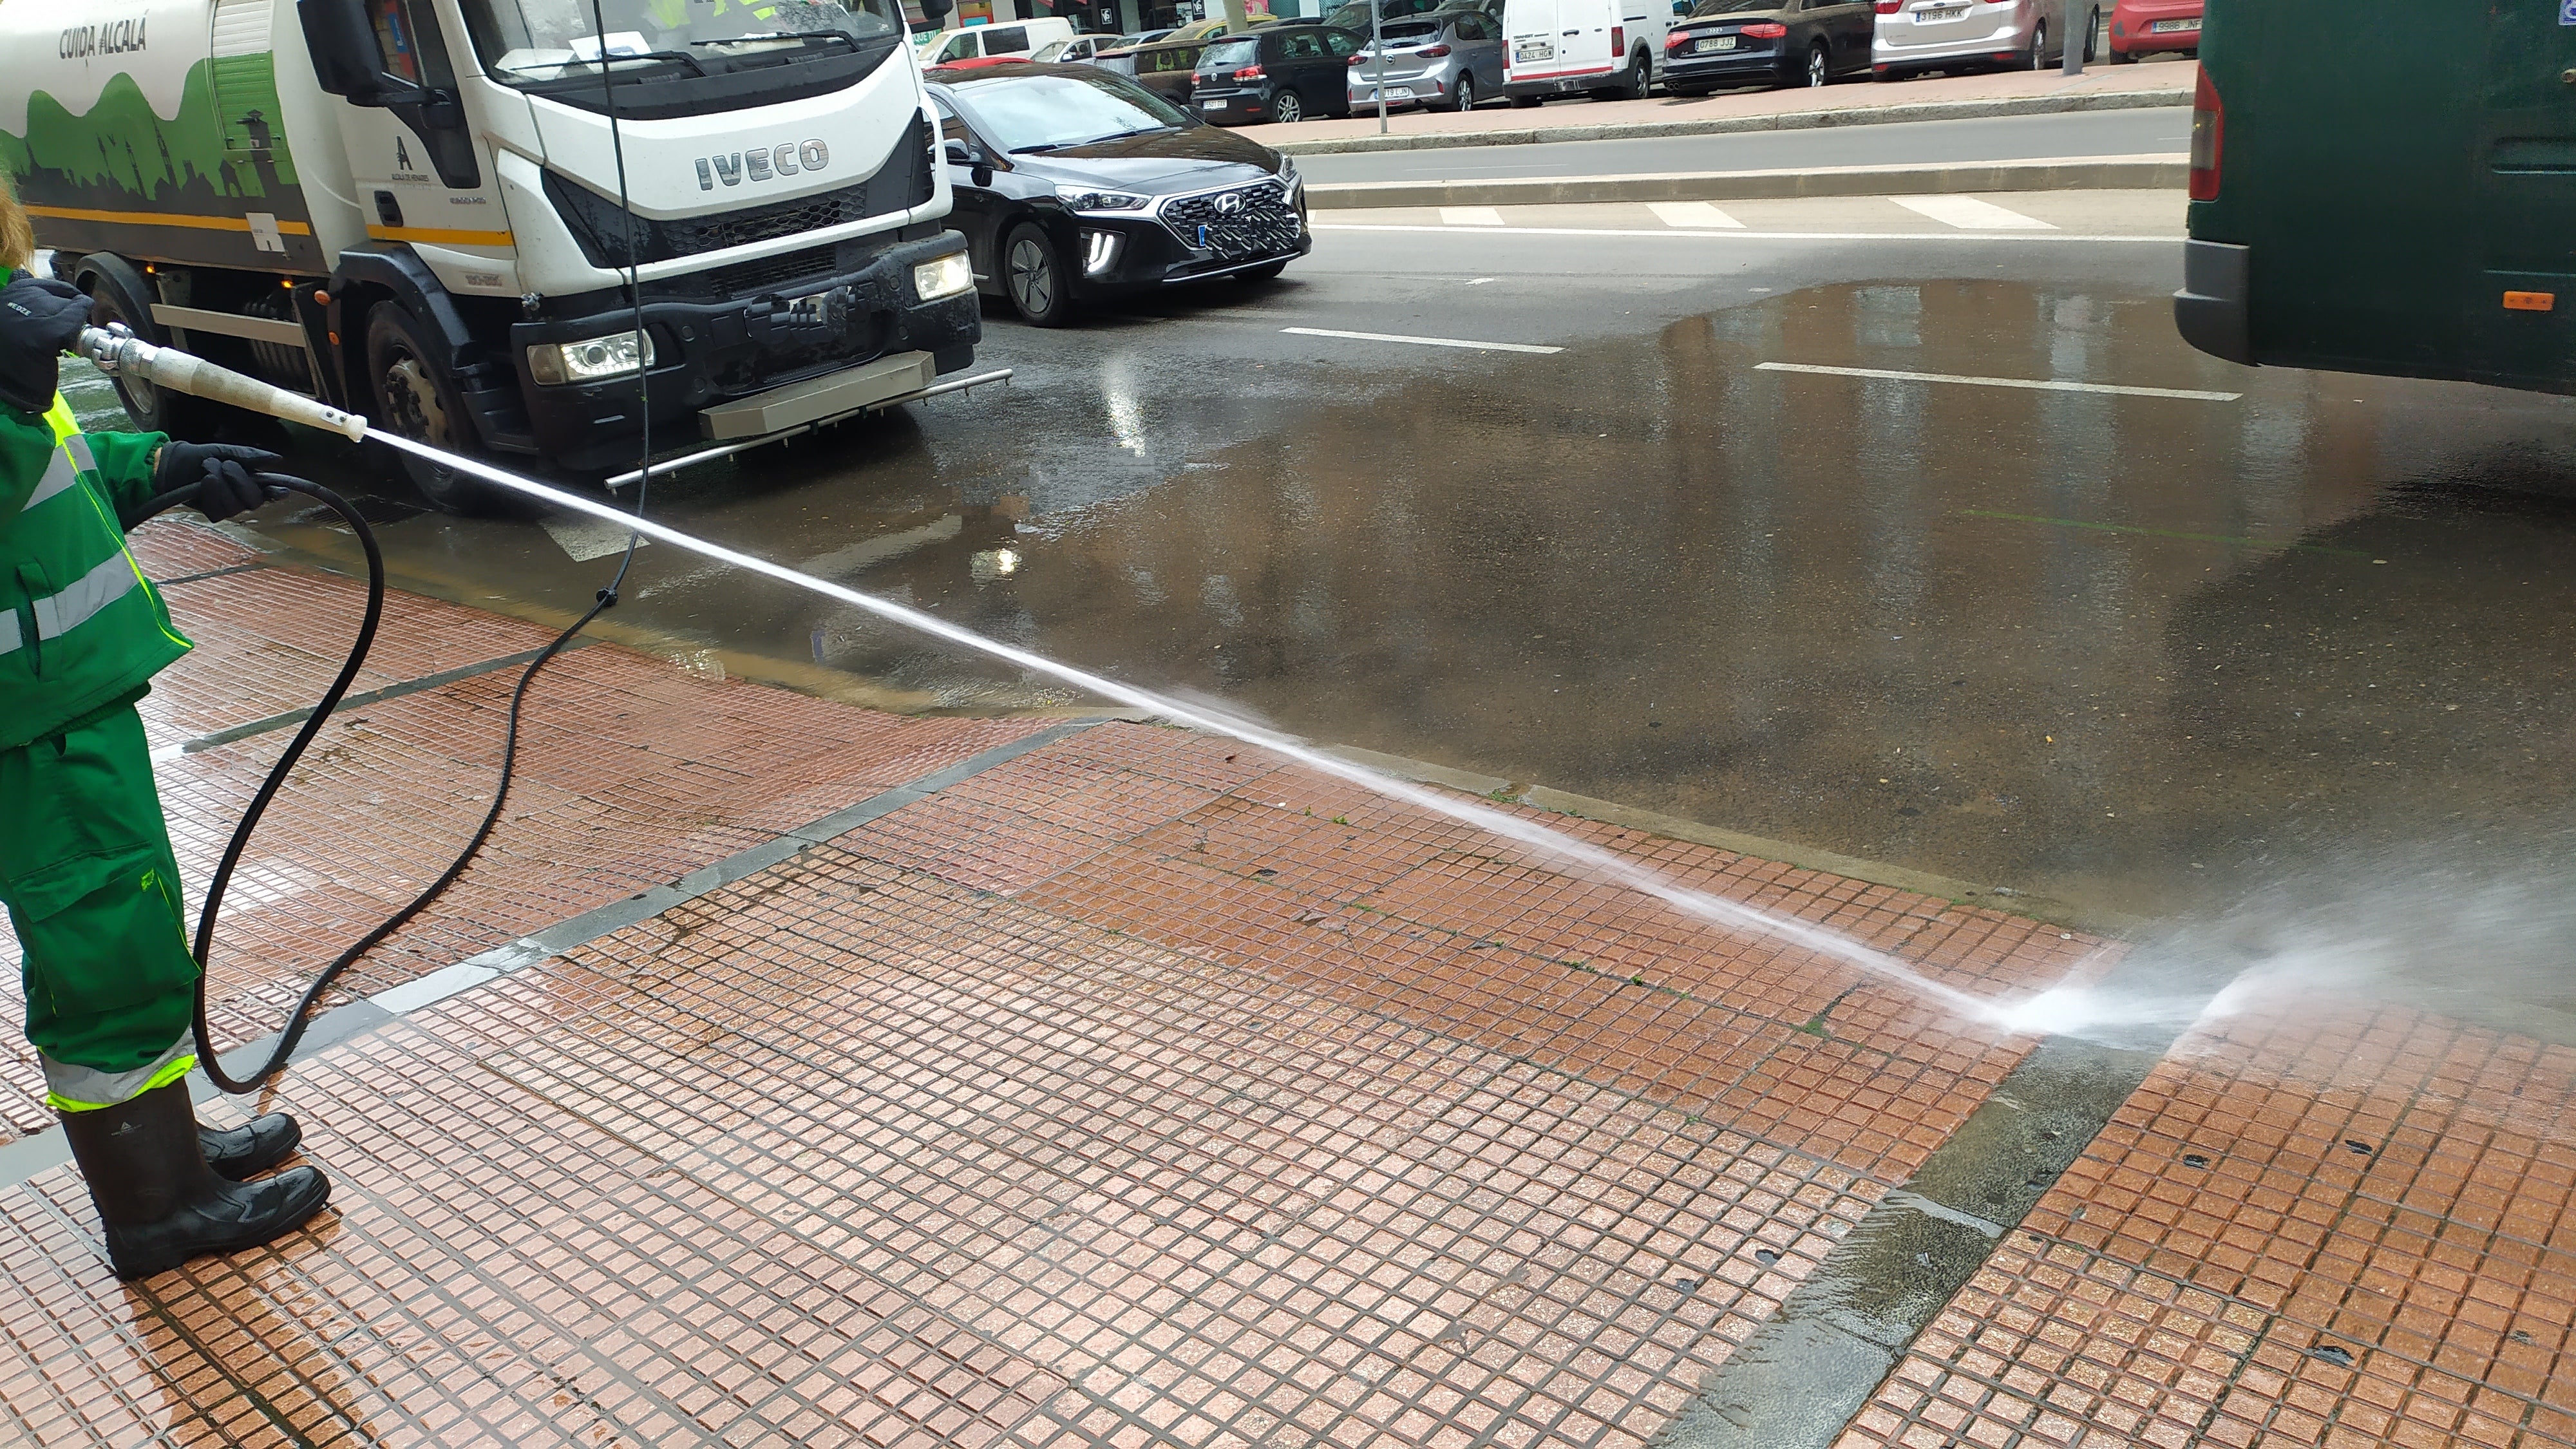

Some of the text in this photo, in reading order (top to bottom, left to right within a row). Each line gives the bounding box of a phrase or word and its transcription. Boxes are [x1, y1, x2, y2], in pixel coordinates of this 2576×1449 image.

[1921, 9, 1963, 21] 3196 HKK
[59, 8, 149, 59] CUIDA ALCALÁ
[1720, 37, 1734, 47] JJZ
[695, 138, 829, 191] IVECO
